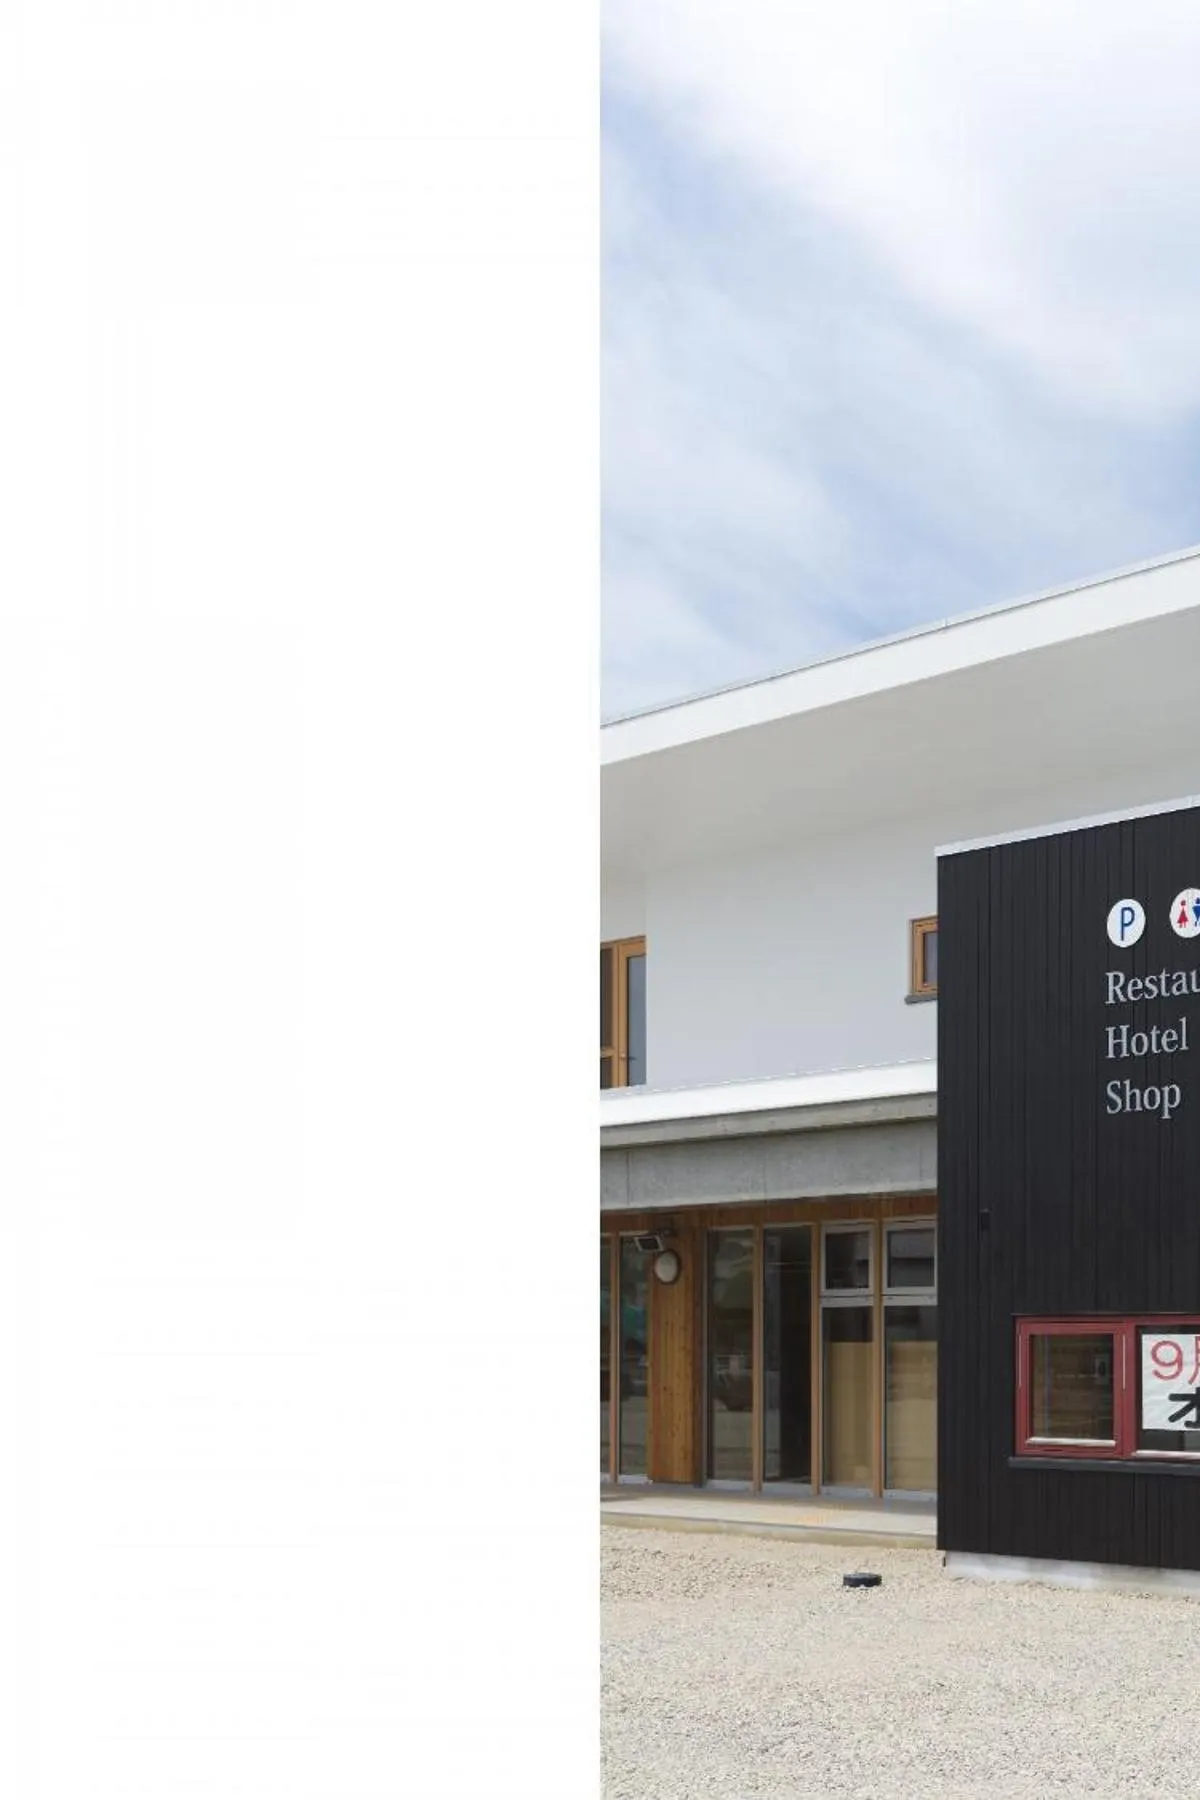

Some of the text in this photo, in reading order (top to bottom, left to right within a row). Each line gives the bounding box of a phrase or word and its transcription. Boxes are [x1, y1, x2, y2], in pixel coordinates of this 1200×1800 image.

[1120, 906, 1136, 942] P
[1105, 1016, 1189, 1059] Hotel
[1106, 1079, 1182, 1120] Shop
